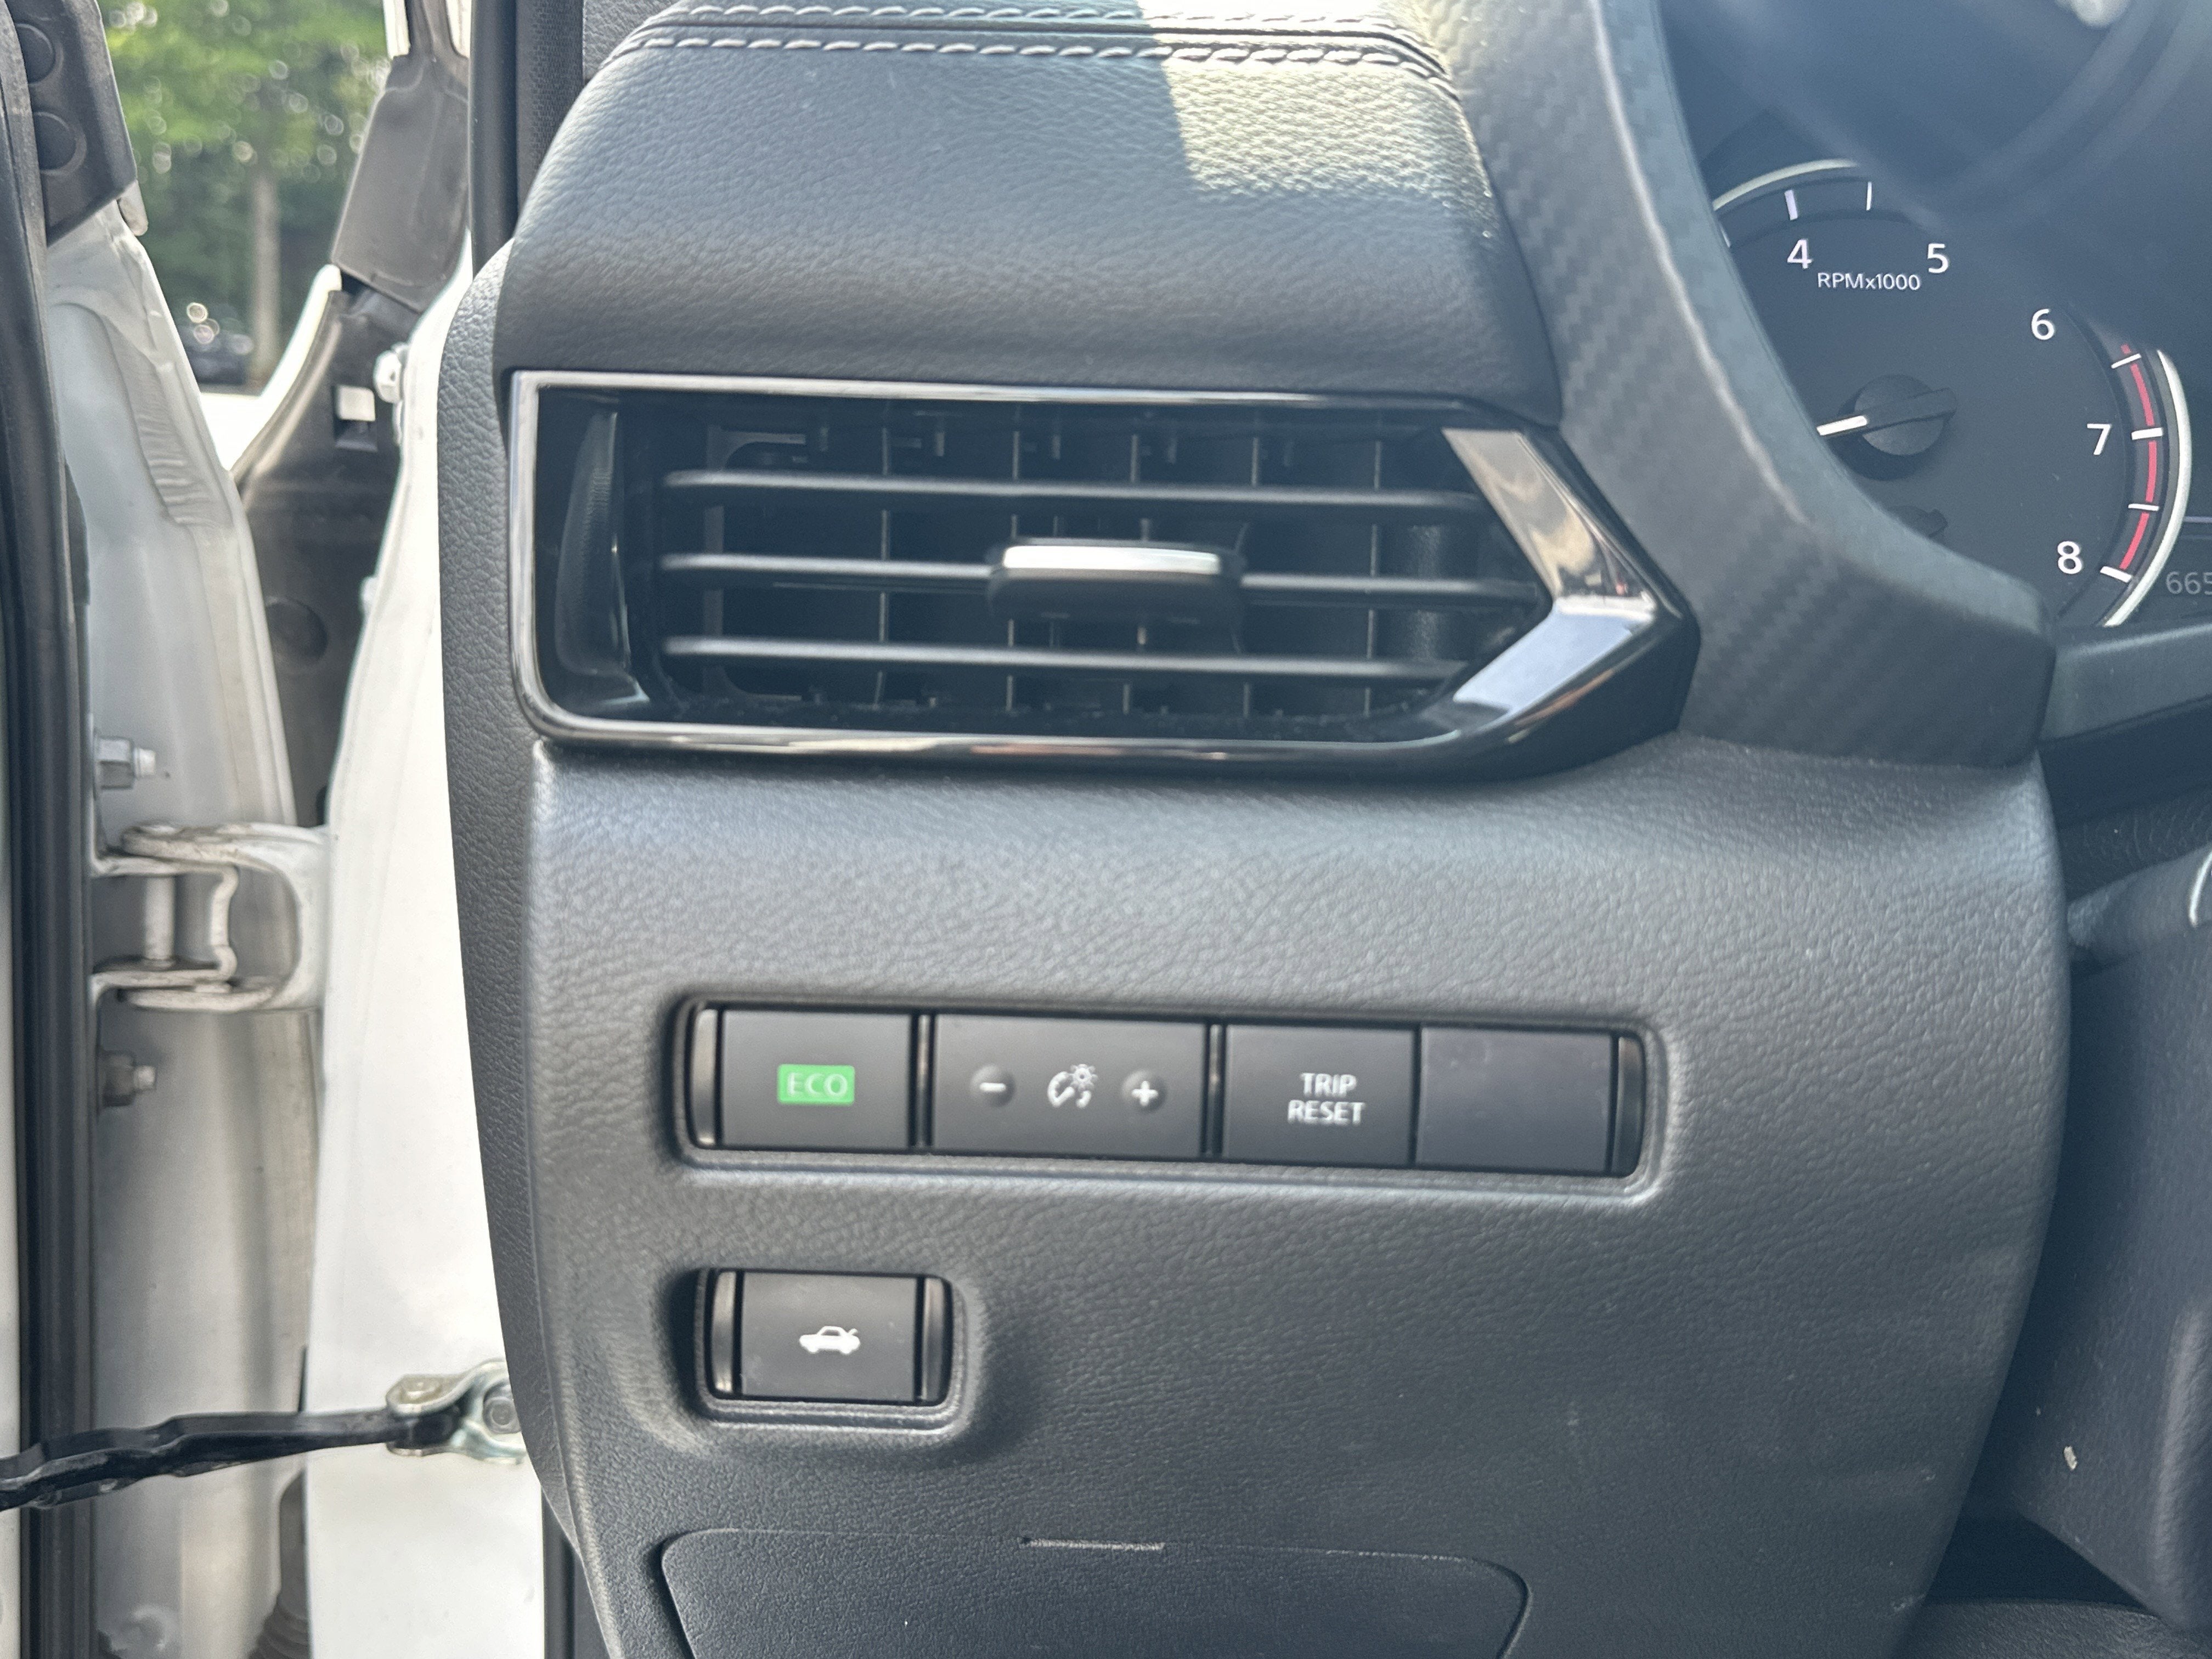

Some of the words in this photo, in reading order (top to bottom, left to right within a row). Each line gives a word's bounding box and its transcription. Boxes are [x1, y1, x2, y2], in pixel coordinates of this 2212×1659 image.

[1787, 238, 1813, 269] 4
[1927, 242, 1949, 274] 5
[1817, 272, 1921, 291] RPMx1000
[2031, 308, 2056, 340] 6
[2086, 422, 2112, 455] 7
[2056, 540, 2083, 575] 8
[787, 1071, 848, 1099] ECO
[1300, 1073, 1357, 1097] TRIP
[1288, 1099, 1366, 1125] RESET
